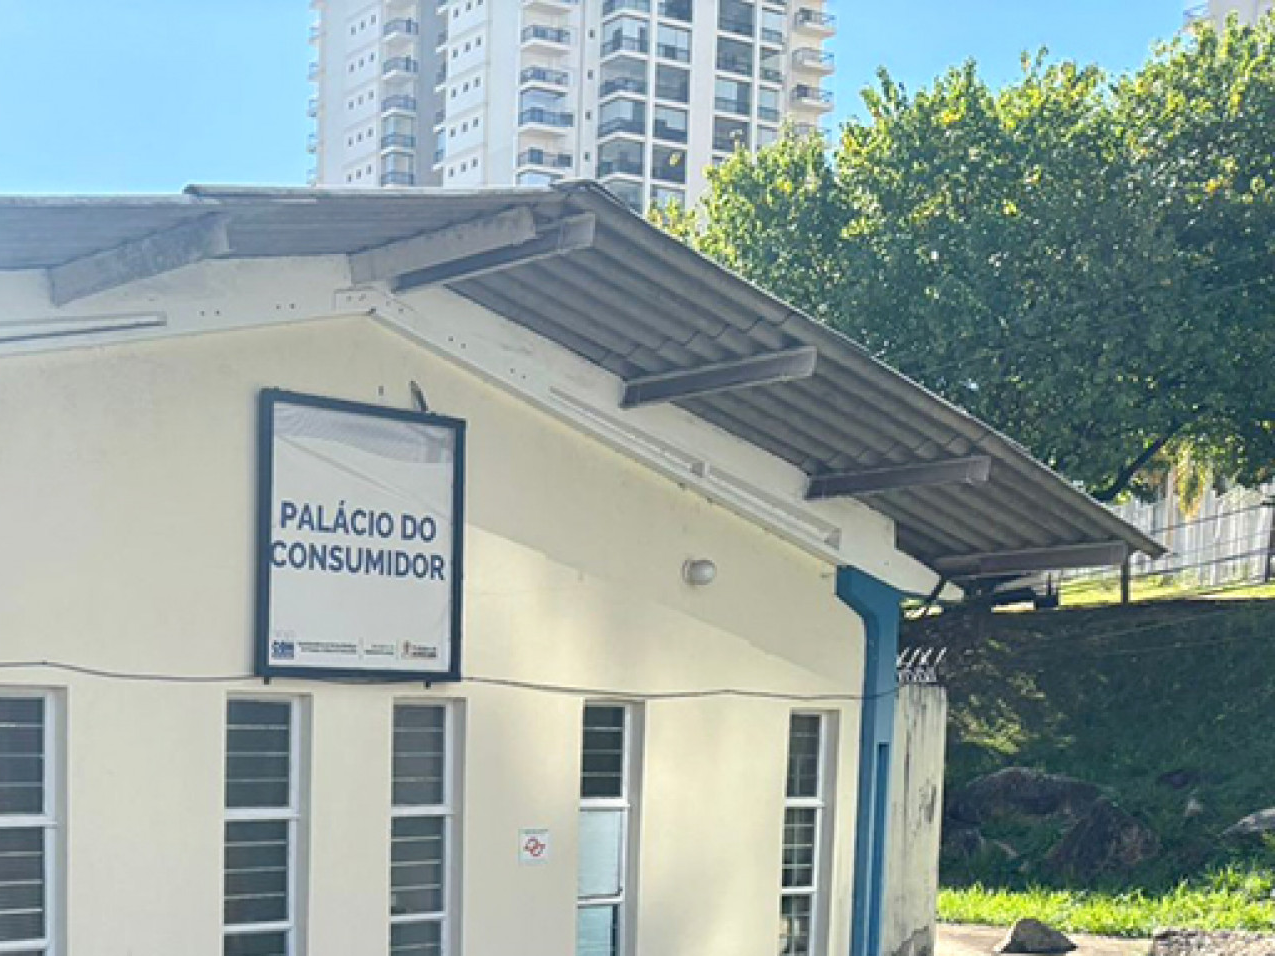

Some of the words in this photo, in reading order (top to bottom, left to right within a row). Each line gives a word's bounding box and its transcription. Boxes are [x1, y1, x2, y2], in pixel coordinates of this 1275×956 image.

[280, 500, 394, 538] PALÁCIO
[400, 514, 436, 542] DO
[272, 540, 445, 580] CONSUMIDOR
